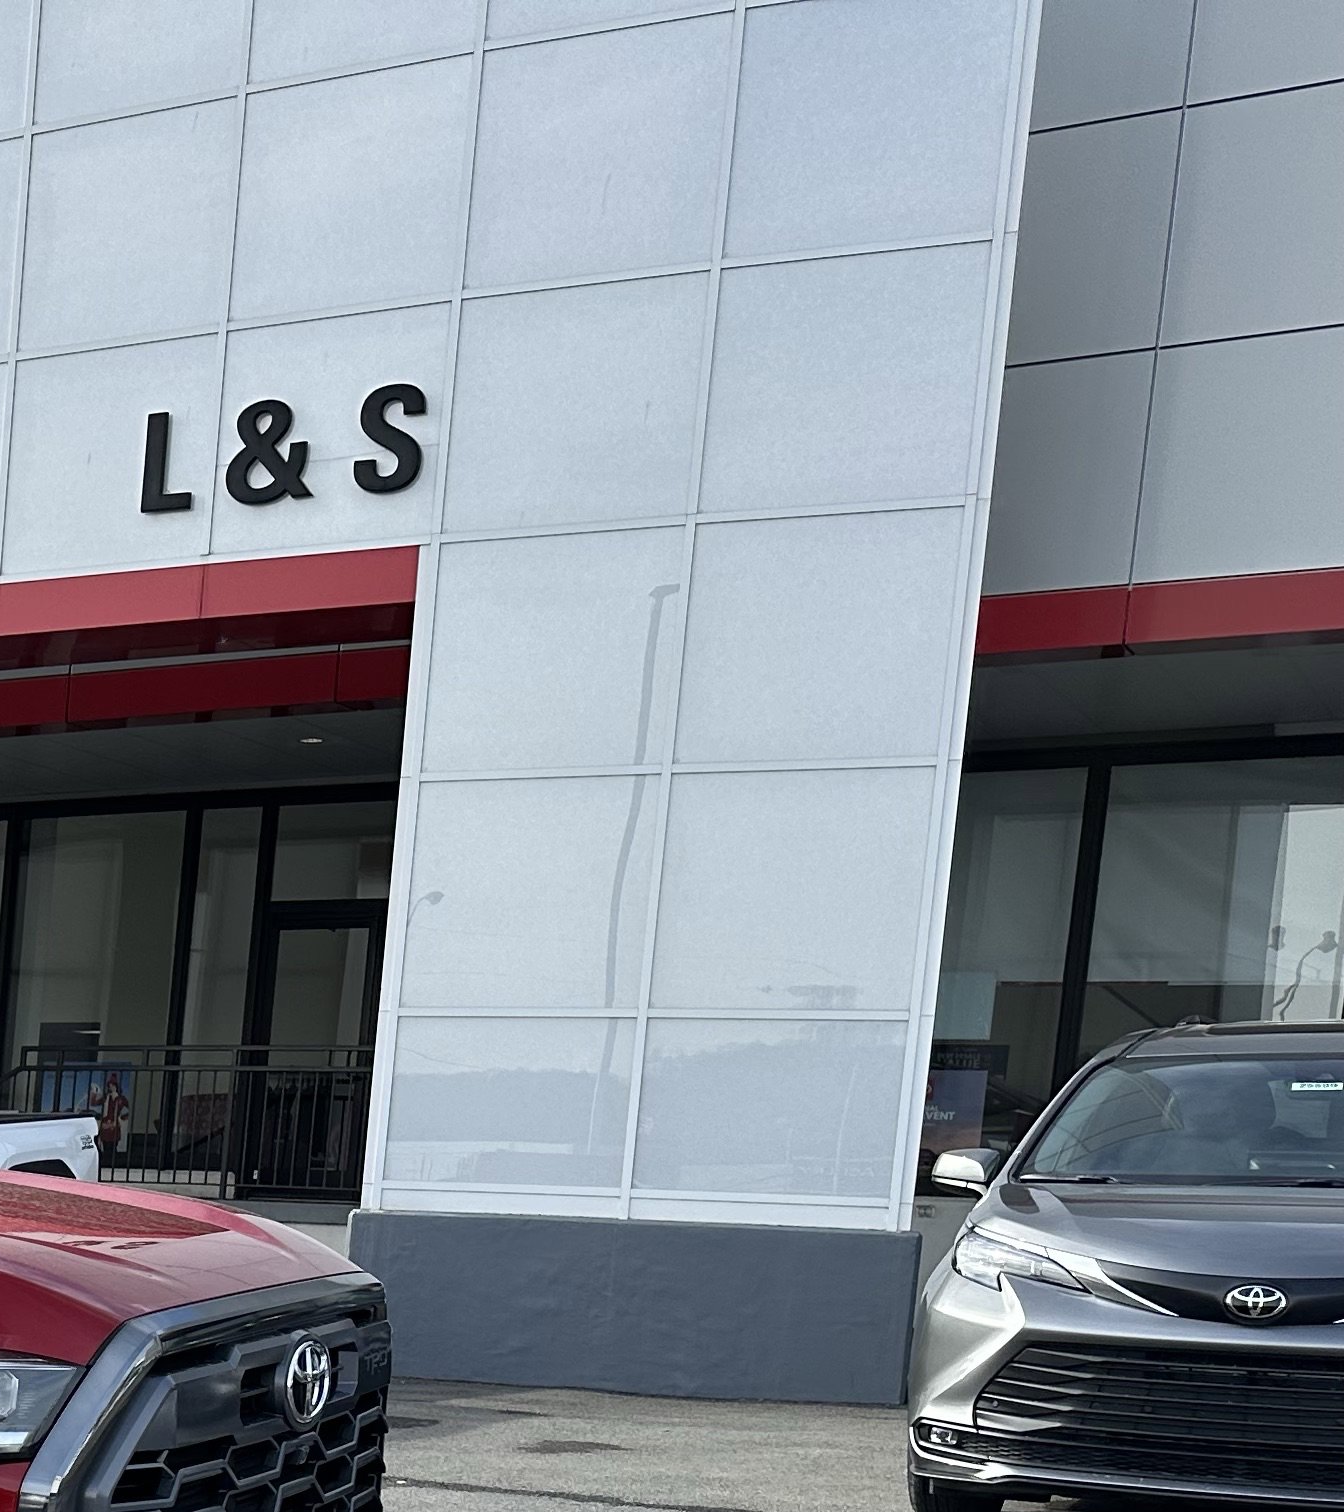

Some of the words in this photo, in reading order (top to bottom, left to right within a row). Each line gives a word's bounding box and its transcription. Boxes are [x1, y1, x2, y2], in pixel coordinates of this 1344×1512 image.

[140, 411, 193, 514] L
[225, 399, 314, 505] &
[353, 383, 428, 494] S
[925, 1111, 955, 1120] VENT
